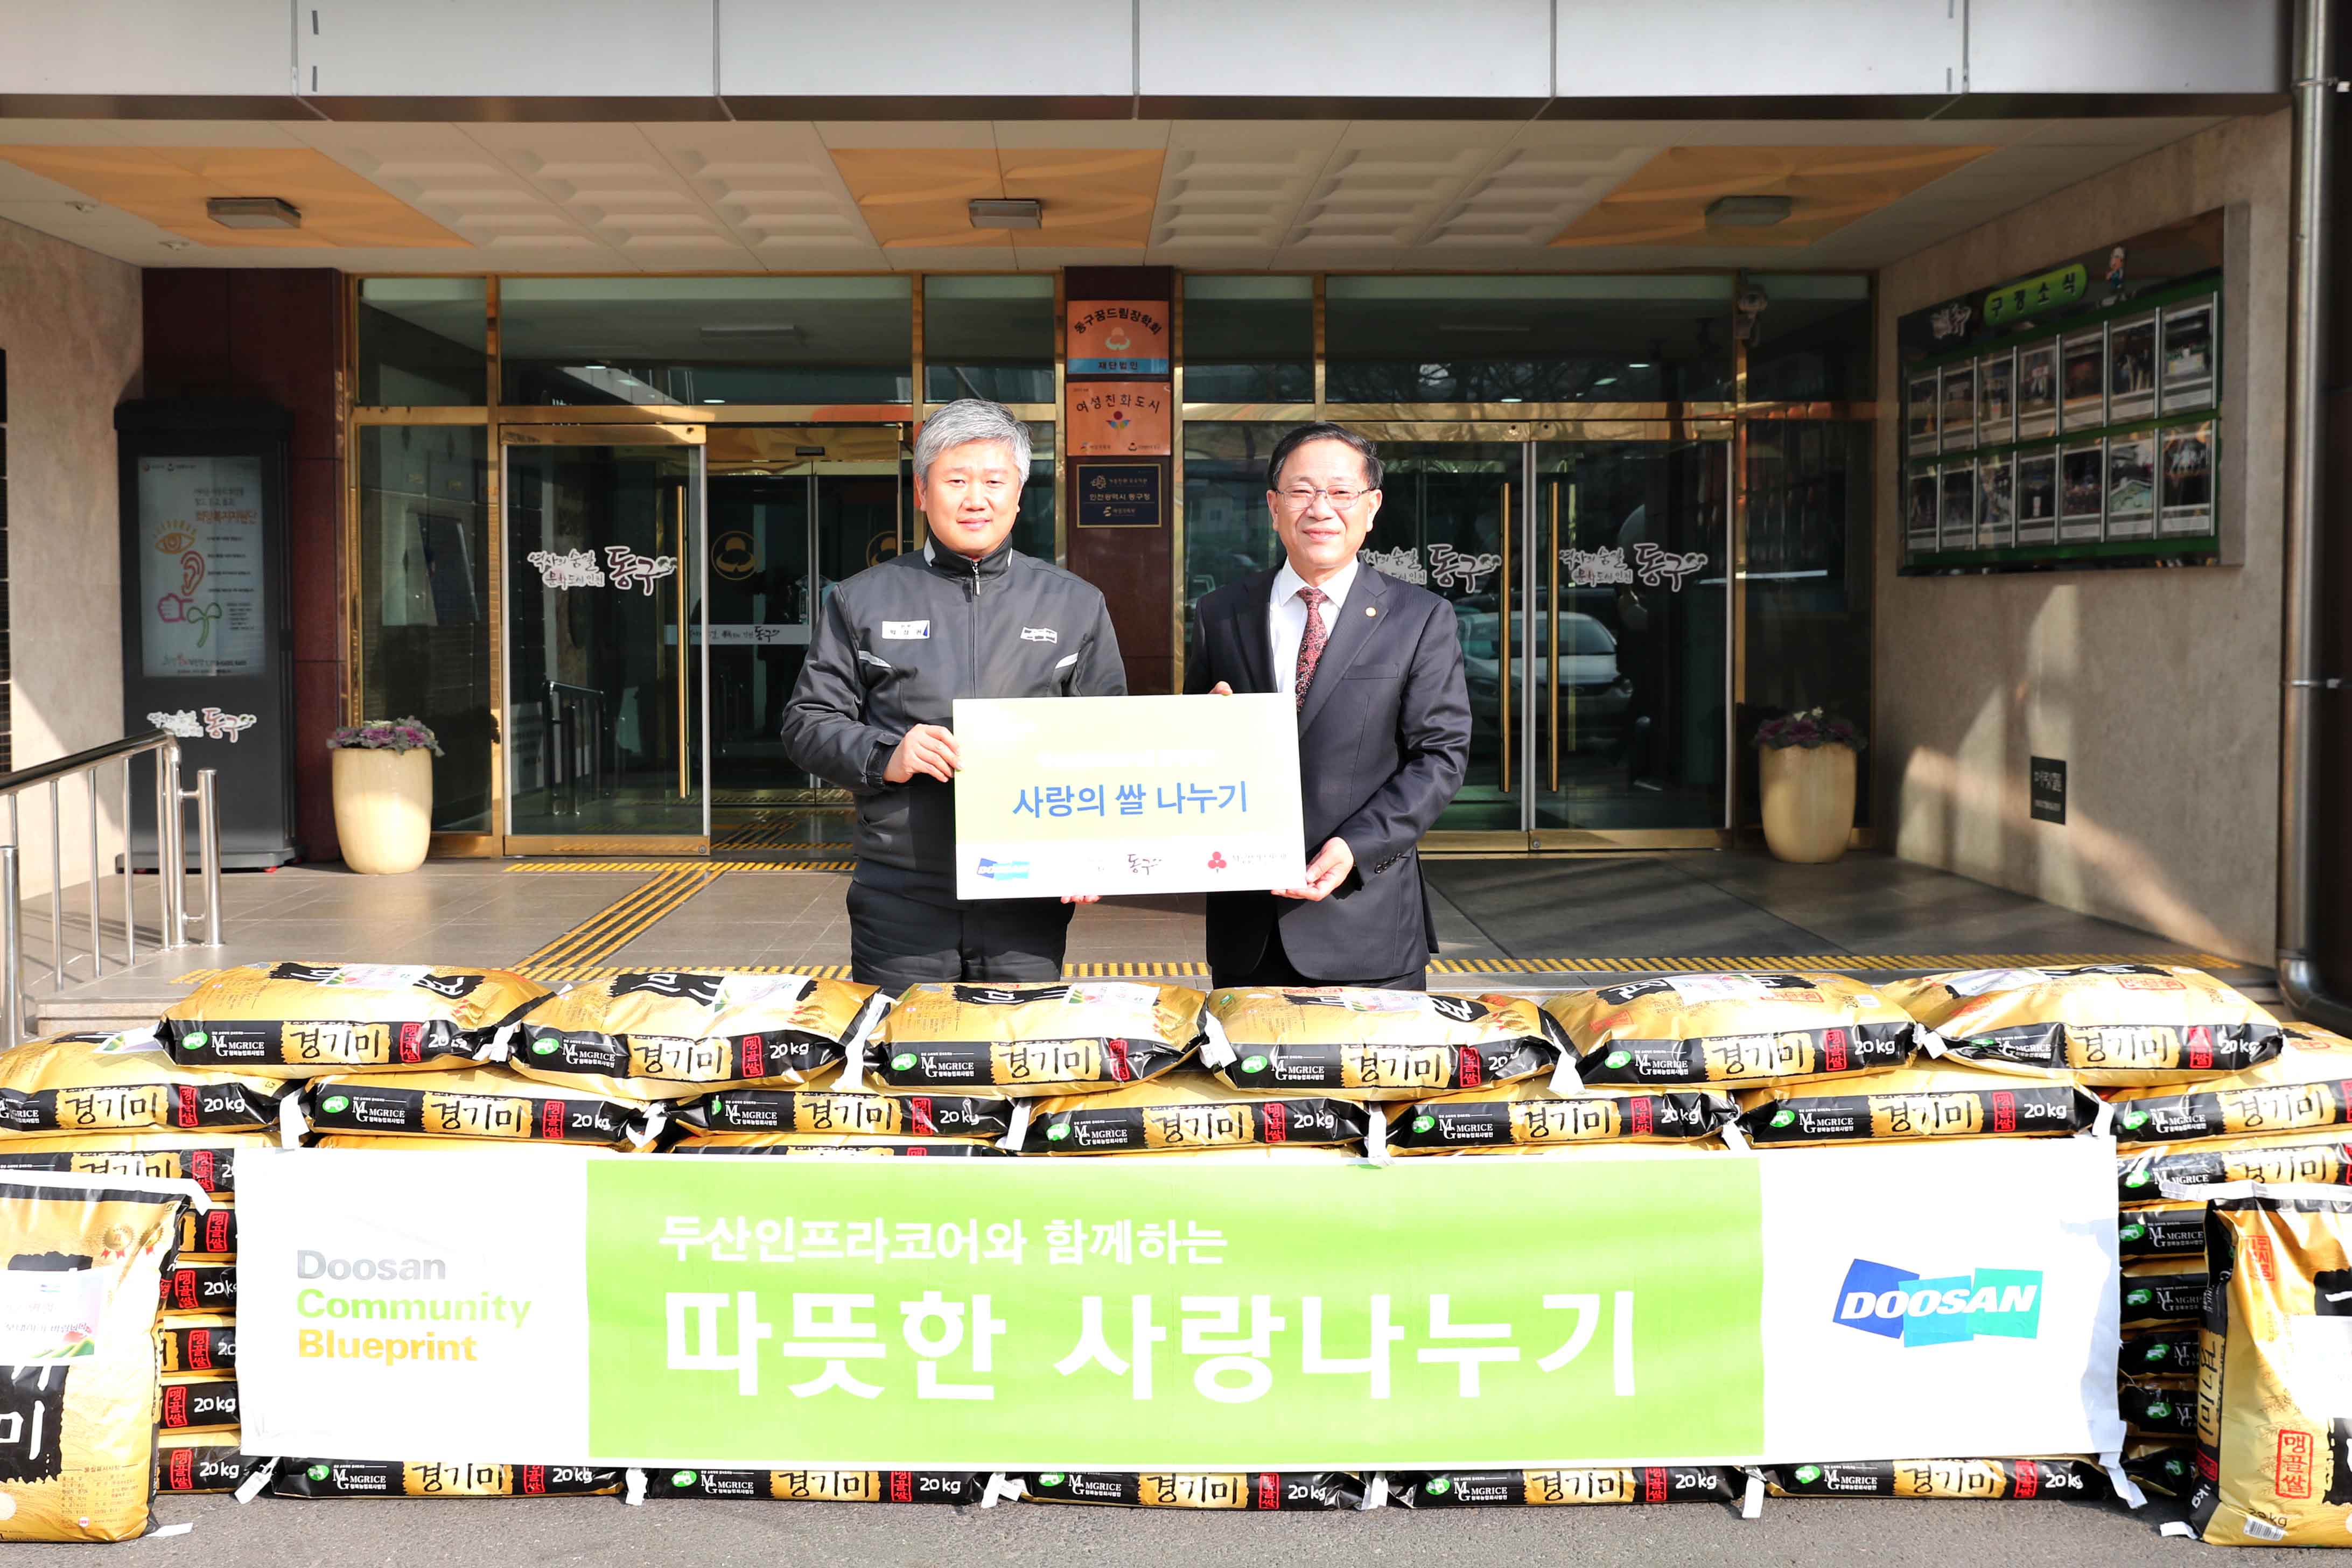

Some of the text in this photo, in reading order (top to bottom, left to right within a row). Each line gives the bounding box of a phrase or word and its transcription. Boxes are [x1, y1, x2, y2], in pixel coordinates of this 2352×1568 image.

[1074, 307, 1162, 335] 동구꿈드림장학회
[1098, 362, 1138, 370] 재단법인
[605, 547, 671, 596] 동구
[1428, 544, 1495, 593] 동구
[1634, 543, 1700, 592] 동구
[1013, 781, 1247, 818] 사랑의 쌀 나누기
[290, 1031, 379, 1058] 경기미
[579, 1051, 615, 1062] MGRICE
[770, 1042, 809, 1059] 20kg
[1713, 1040, 1803, 1074] 경기미
[1855, 1040, 1895, 1055] 20kg
[2075, 1032, 2167, 1062] 경기미
[635, 1045, 723, 1074] 경기미
[999, 1048, 1090, 1079] 경기미
[1288, 1066, 1324, 1074] MGRICE
[1349, 1053, 1440, 1082] 경기미
[11, 1109, 39, 1118] GRICE
[65, 1094, 156, 1124] 경기미
[204, 1097, 245, 1113] 20kg
[369, 1109, 405, 1118] MGRICE
[431, 1101, 521, 1130] 경기미
[742, 1111, 777, 1119] MGRICE
[802, 1100, 892, 1130] 경기미
[1661, 1108, 1700, 1124] 20kg
[1879, 1101, 1971, 1132] 경기미
[2024, 1102, 2067, 1119] 20kg
[2229, 1090, 2324, 1127] 경기미
[572, 1114, 610, 1130] 20kg
[1091, 1129, 1128, 1138] MGRICE
[1152, 1112, 1242, 1142] 경기미
[1294, 1113, 1334, 1129] 20kg
[1457, 1124, 1493, 1132] MGRICE
[1526, 1107, 1610, 1137] 경기미
[1817, 1118, 1853, 1126] MGRICE
[659, 1216, 1228, 1265] 두산인프라코어와 함께하는
[2167, 1231, 2204, 1240] MGRICE
[297, 1249, 446, 1280] Doosan
[297, 1288, 532, 1329] Community
[1840, 1285, 2038, 1319] DOOSAN
[299, 1328, 477, 1366] Blueprint
[666, 1290, 1635, 1404] 따뜻한 사랑나누기
[167, 1388, 186, 1426] 맹골쌀
[194, 1397, 236, 1412] 20kg
[172, 1451, 190, 1488] 맹골쌀
[199, 1462, 239, 1478] 20kg
[412, 1464, 502, 1492] 경기미
[552, 1467, 592, 1483] 20kg
[2281, 1434, 2308, 1495] 맹골쌀
[718, 1482, 754, 1490] MGRICE
[779, 1472, 870, 1497] 경기미
[920, 1477, 961, 1494] 20kg
[1085, 1482, 1122, 1490] MGRICE
[1147, 1475, 1237, 1504] 경기미
[1288, 1485, 1326, 1502] 20kg
[1471, 1487, 1507, 1495] MGRICE
[1533, 1472, 1622, 1501] 경기미
[1676, 1474, 1717, 1489] 20kg
[1903, 1467, 1994, 1494] 경기미
[2046, 1473, 2083, 1489] 20kg
